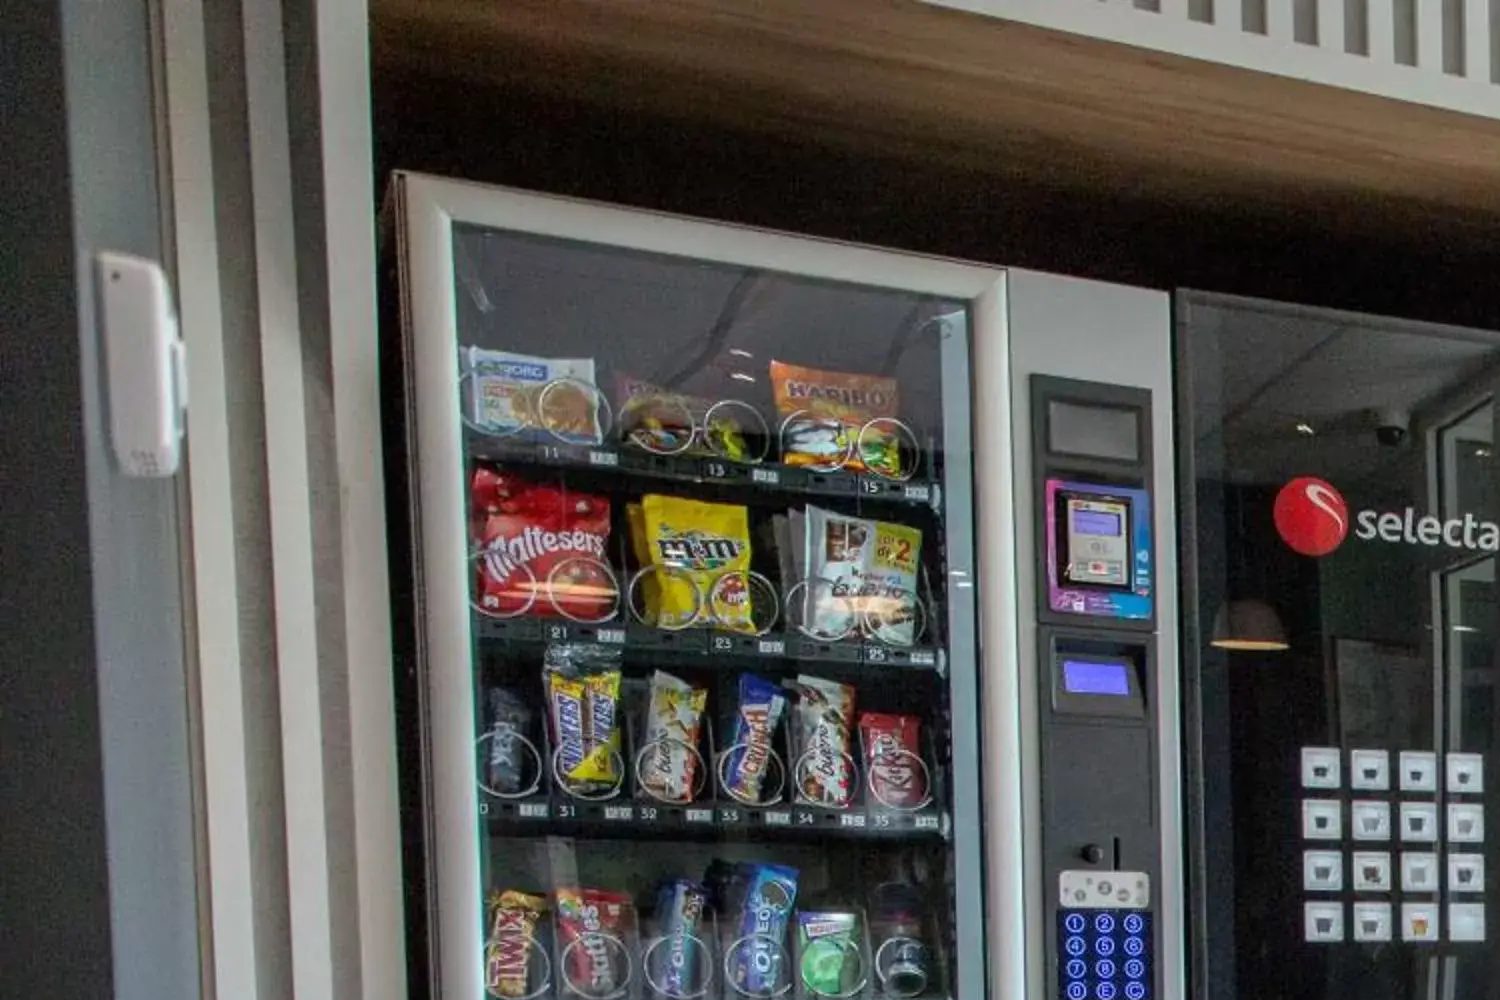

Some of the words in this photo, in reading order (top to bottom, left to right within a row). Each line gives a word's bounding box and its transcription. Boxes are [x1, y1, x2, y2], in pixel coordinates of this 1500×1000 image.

[786, 380, 889, 407] HARIBO
[709, 463, 725, 477] 13
[863, 481, 878, 493] 15
[1355, 507, 1500, 551] selecta
[484, 526, 604, 583] Maltesers
[551, 626, 567, 639] 21
[715, 637, 732, 649] 23
[869, 648, 885, 661] 25
[560, 805, 575, 817] 31
[799, 812, 814, 825] 34
[874, 815, 890, 827] 35
